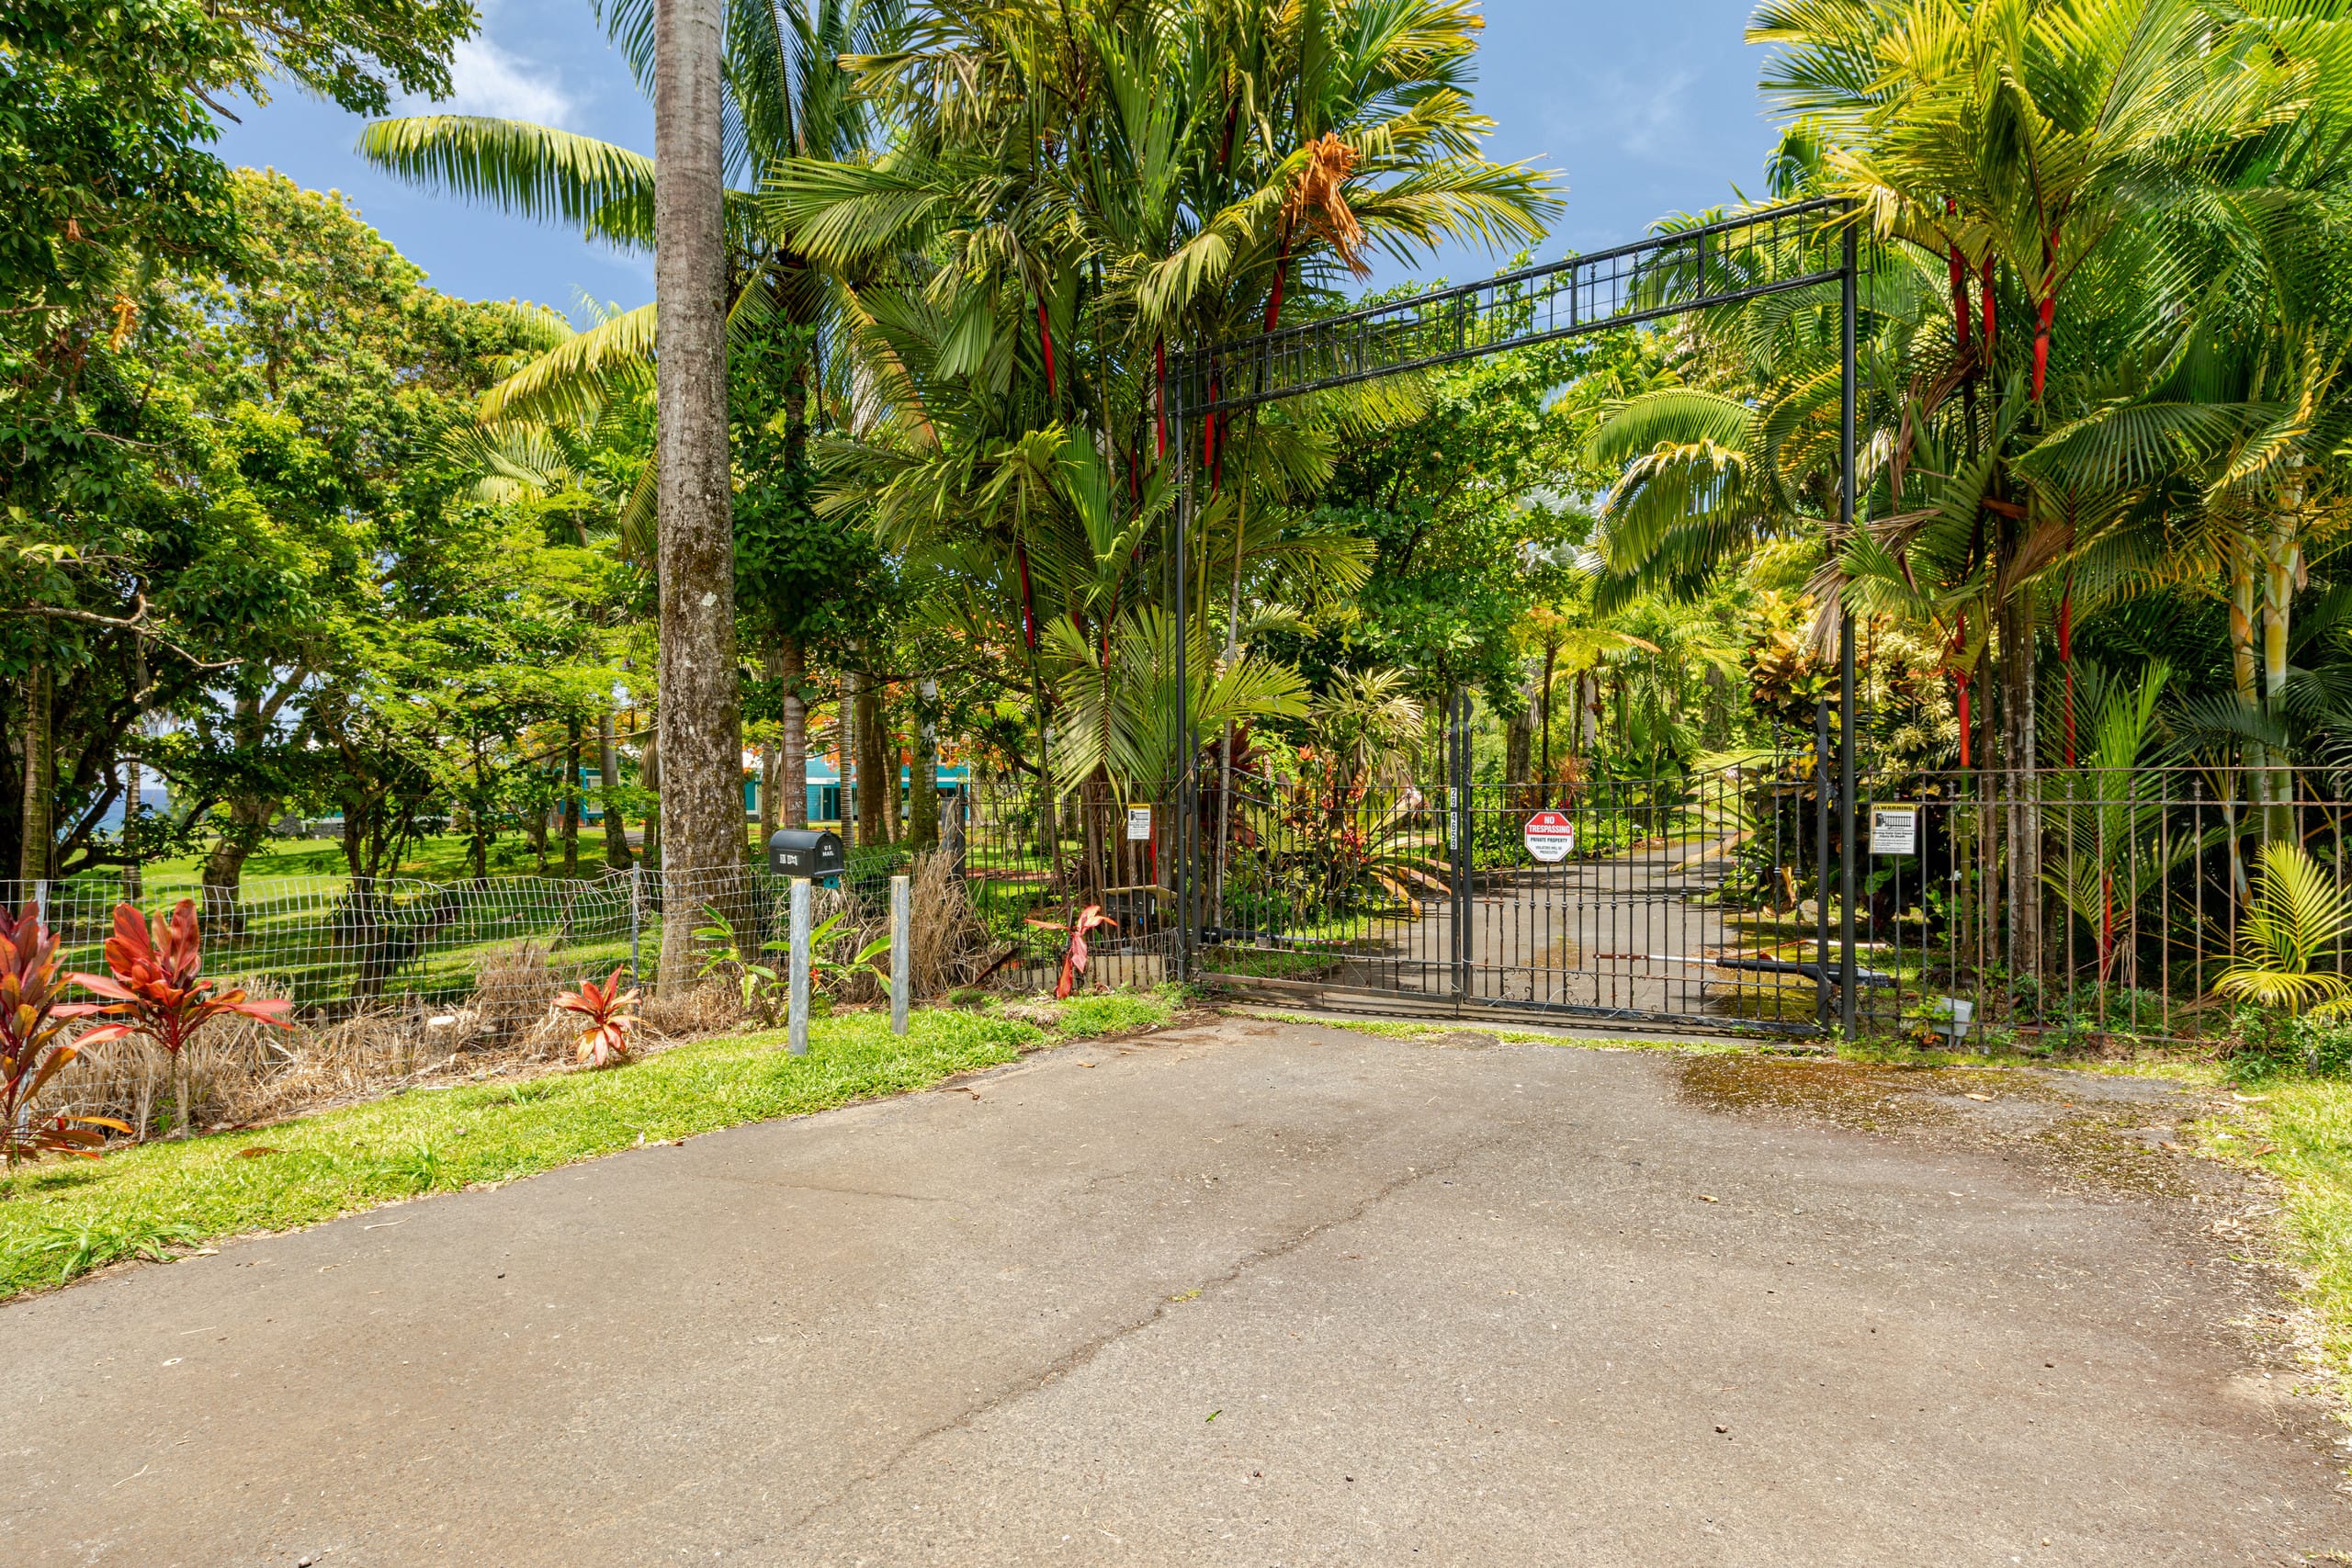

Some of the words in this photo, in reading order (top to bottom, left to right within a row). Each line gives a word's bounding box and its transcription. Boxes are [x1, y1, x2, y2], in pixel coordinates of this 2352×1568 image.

[1451, 788, 1456, 807] 29
[1544, 816, 1555, 825] NO
[1528, 825, 1571, 834] TRESPASSING
